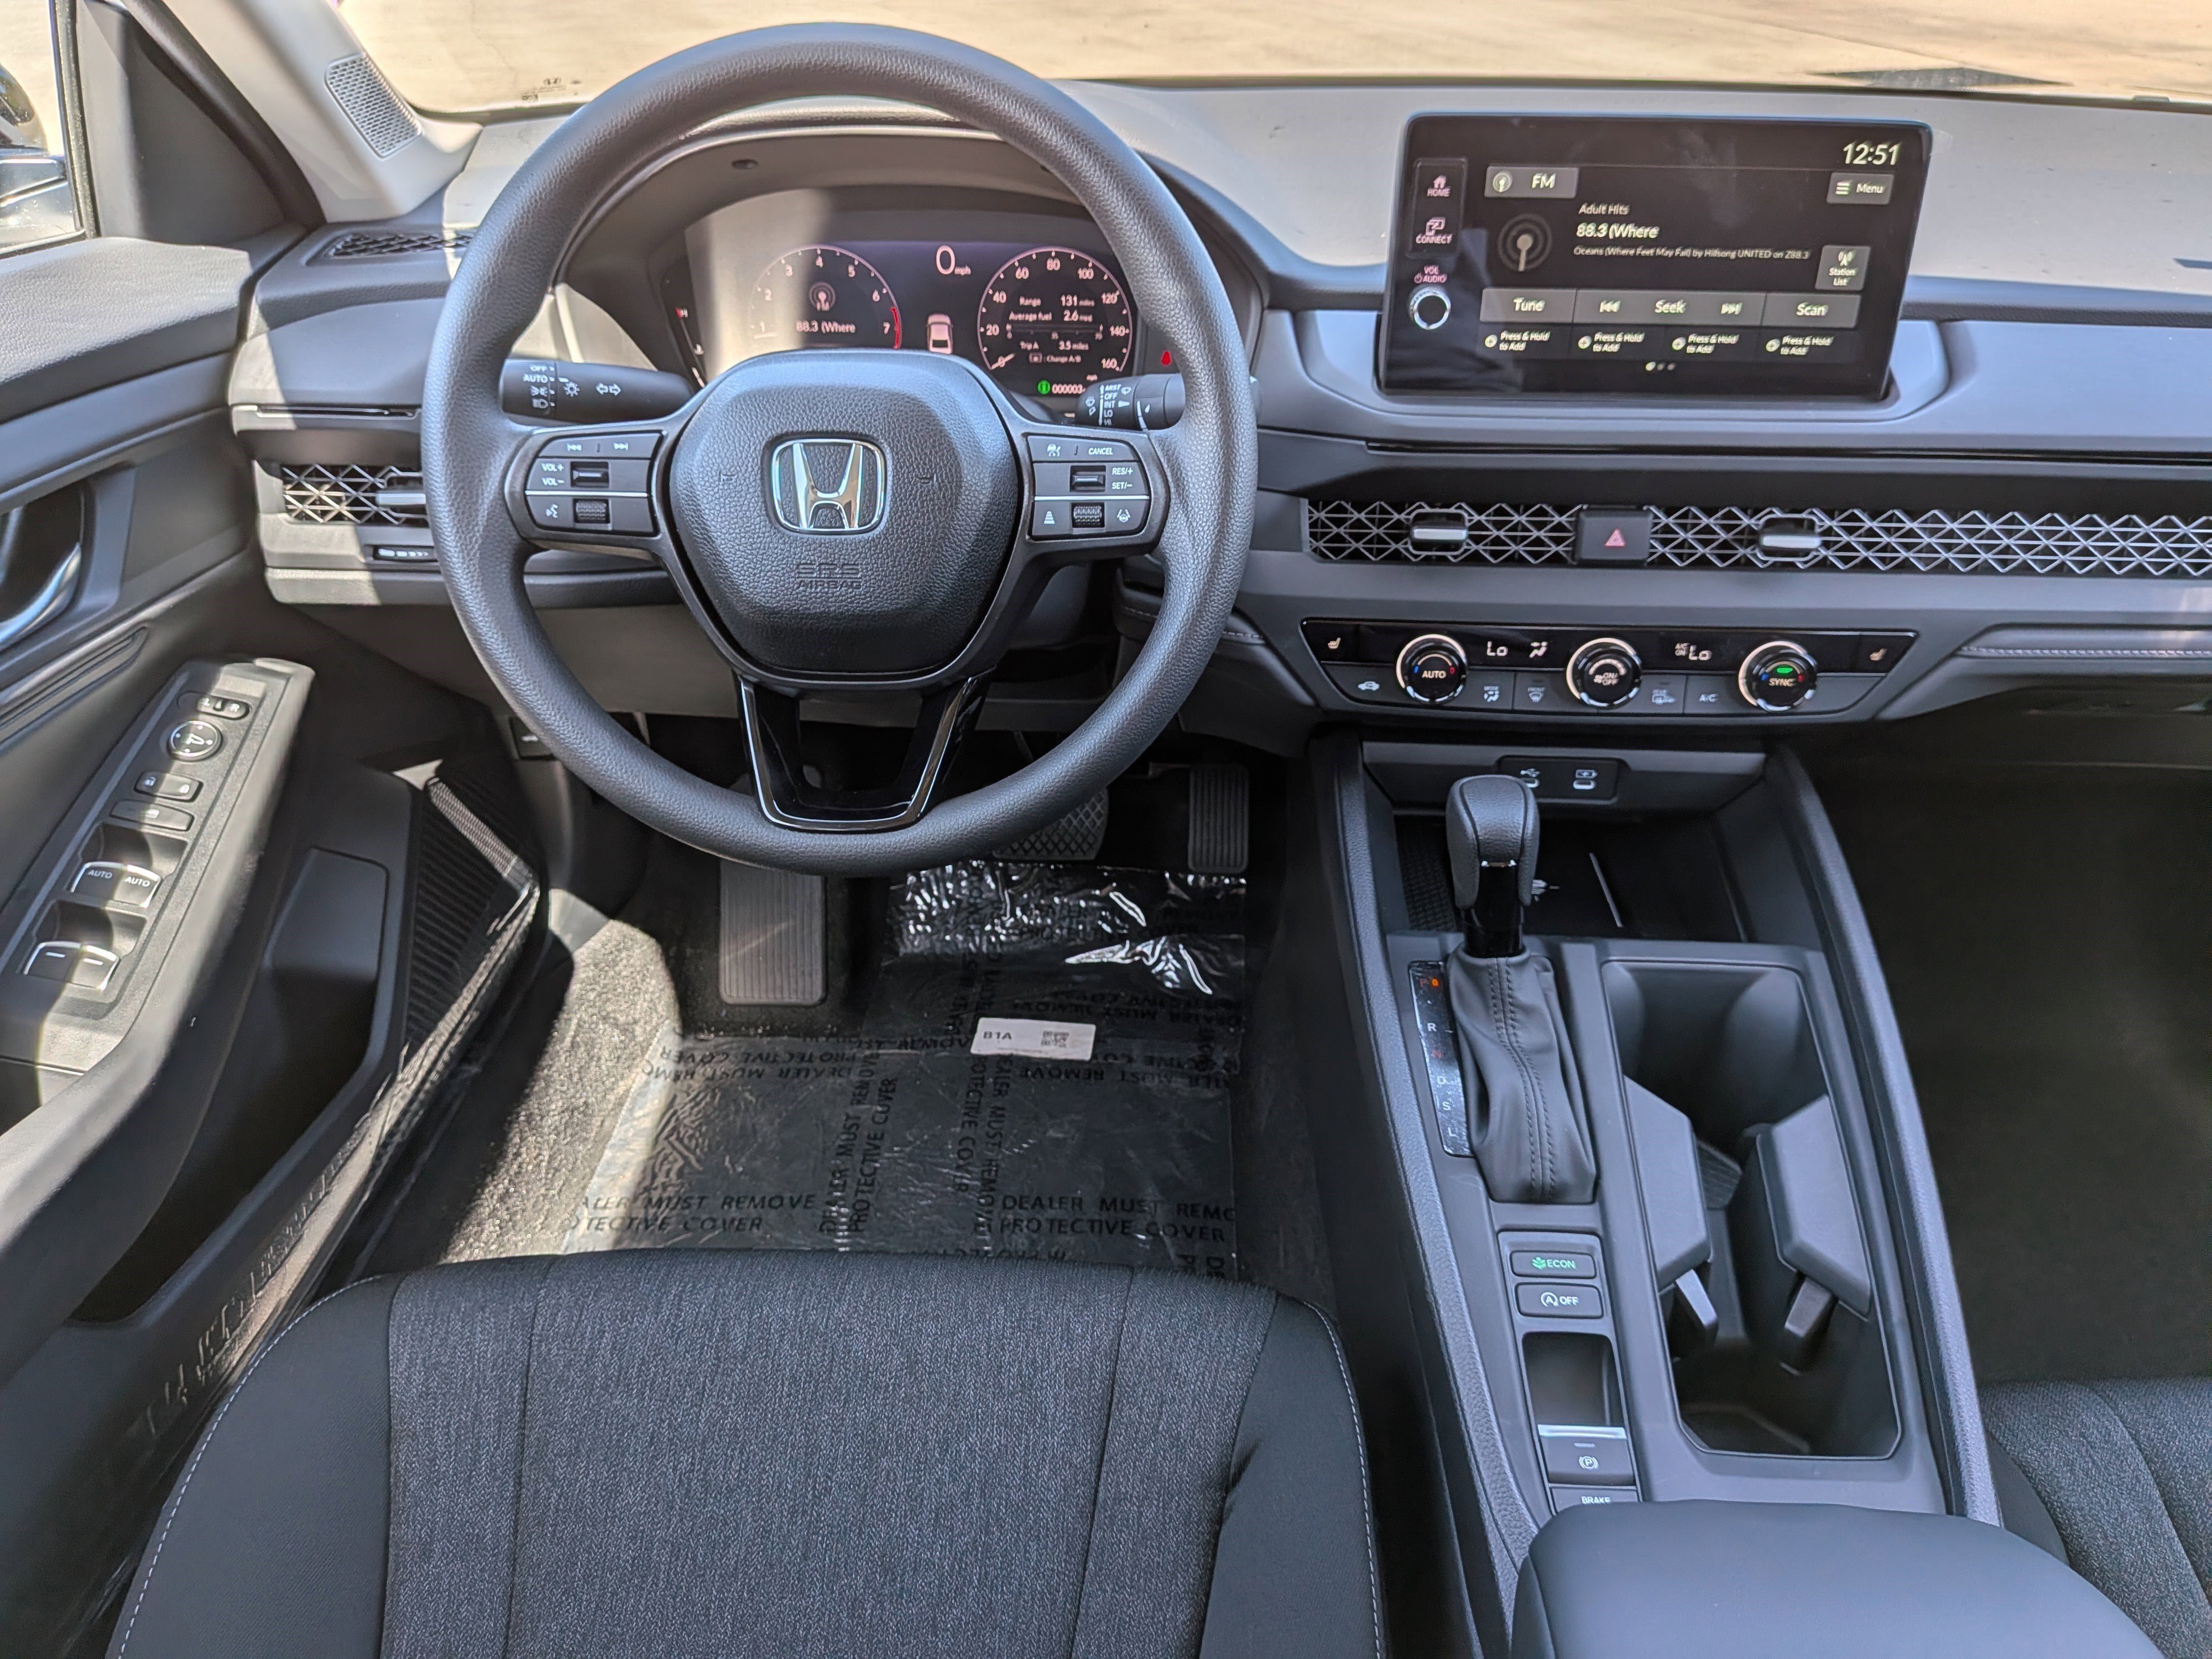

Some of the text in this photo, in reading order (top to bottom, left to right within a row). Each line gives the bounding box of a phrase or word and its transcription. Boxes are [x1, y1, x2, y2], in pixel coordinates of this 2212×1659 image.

[1843, 142, 1900, 165] 12:51
[1531, 173, 1556, 189] FM
[1856, 183, 1884, 194] Menu
[1579, 202, 1630, 215] Adult Hits
[1576, 222, 1660, 239] 88.3 (Where
[1416, 234, 1452, 244] CONNECT
[1573, 246, 1604, 256] Oceans
[1604, 247, 1634, 257] (Where
[1636, 247, 1653, 257] Feet
[1656, 247, 1673, 258] May
[1692, 248, 1703, 258] by
[1738, 249, 1771, 259] UNITED
[816, 255, 824, 268] 4
[936, 245, 956, 275] 0
[1046, 258, 1061, 272] 80
[785, 264, 855, 278] 3 5
[954, 265, 971, 276] mph
[1015, 267, 1094, 280] 60 100
[1424, 265, 1439, 275] VOL
[1829, 268, 1855, 276] Station
[1422, 274, 1447, 283] AUDIO
[1833, 277, 1849, 286] List
[765, 288, 880, 302] 2 6
[993, 291, 1007, 304] 40
[1019, 294, 1095, 307] Range 131 miles
[1101, 293, 1118, 304] 120
[1514, 297, 1546, 312] Tune
[1655, 299, 1687, 314] Seek
[1796, 302, 1829, 316] Scan
[1009, 311, 1037, 322] Average
[1038, 311, 1052, 321] fuel
[1063, 309, 1078, 321] 2.6
[760, 321, 890, 334] 1 7
[796, 321, 856, 333] 88.3 (Where
[985, 324, 1000, 336] 20
[1109, 325, 1125, 337] 140
[1500, 331, 1521, 341] Press
[1530, 331, 1551, 342] Hold
[1594, 332, 1615, 342] Press
[1624, 332, 1645, 343] Hold
[1688, 333, 1709, 344] Press
[1718, 335, 1739, 345] Hold
[1782, 335, 1803, 346] Press
[1812, 336, 1834, 346] Hold
[1020, 341, 1032, 351] Trip
[1032, 341, 1039, 349] A
[1058, 340, 1071, 351] 3.5
[1499, 342, 1526, 351] to Add
[1593, 343, 1621, 352] to Add
[1686, 345, 1714, 354] to Add
[1780, 346, 1809, 356] to Add
[1046, 354, 1068, 363] Change
[1101, 358, 1117, 369] 160
[523, 374, 548, 383] AUTO
[1051, 383, 1083, 394] 000003
[1104, 392, 1118, 400] OFF
[1103, 409, 1113, 418] LO
[1088, 447, 1113, 455] CANCEL
[796, 562, 861, 578] SRS
[1421, 670, 1446, 679] AUTO
[1768, 679, 1795, 687] SYNC
[1699, 693, 1719, 702] A/C
[87, 869, 113, 879] AUTO
[124, 876, 150, 888] AUTO
[1427, 1022, 1437, 1032] R
[983, 1030, 1012, 1040] B1A
[1442, 1102, 1451, 1111] S
[1448, 1128, 1457, 1136] L
[848, 1132, 885, 1232] PROTECTIVE
[721, 1194, 816, 1210] REMOVE
[1002, 1195, 1083, 1212] DEALER
[1099, 1196, 1160, 1214] MUST
[682, 1217, 762, 1232] COVER
[1000, 1218, 1224, 1242] PROTECTIVE COVER
[1546, 1259, 1576, 1269] ECON
[1559, 1296, 1579, 1306] OFF
[1581, 1496, 1611, 1504] BRAKE
